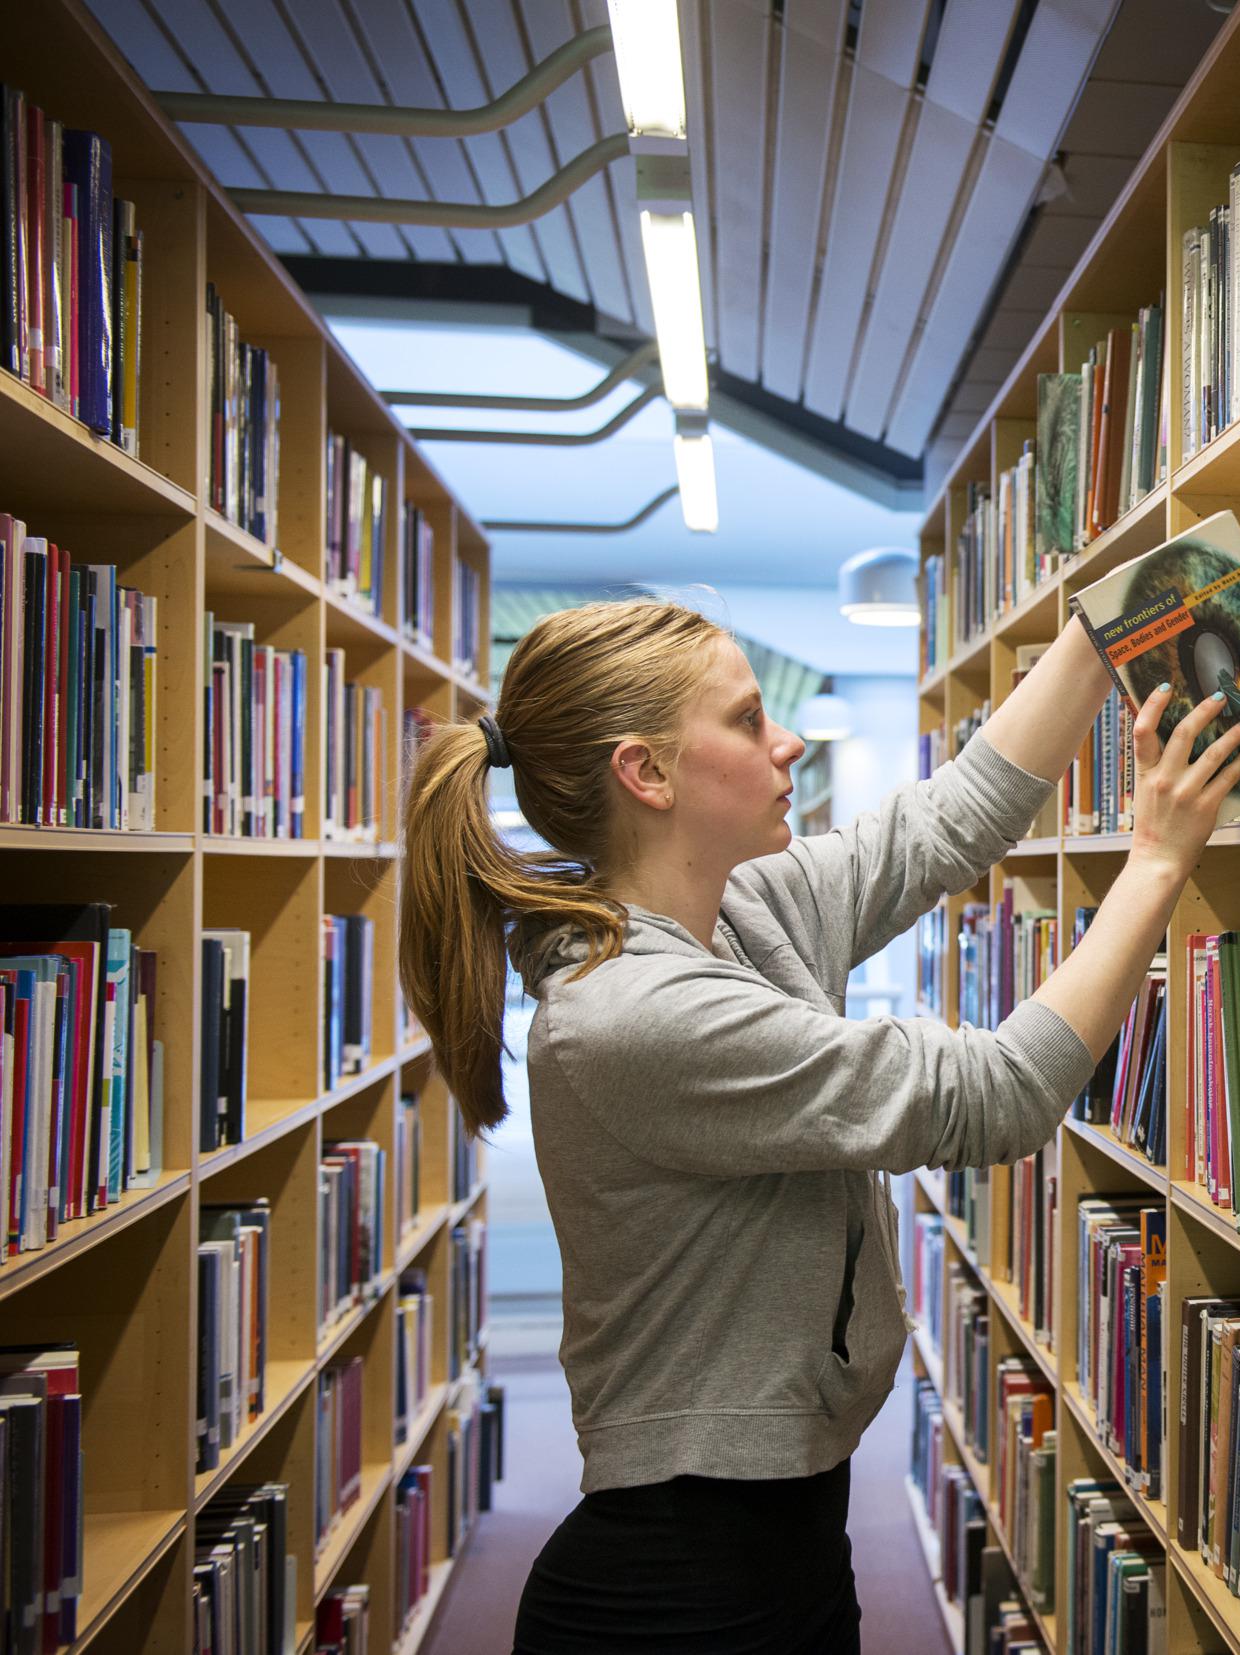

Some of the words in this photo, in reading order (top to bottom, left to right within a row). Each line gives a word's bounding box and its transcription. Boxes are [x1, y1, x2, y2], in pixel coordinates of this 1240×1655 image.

[1104, 624, 1124, 641] new
[1123, 602, 1166, 630] frontiers
[1166, 593, 1177, 606] of
[1109, 643, 1132, 661] Space,
[1131, 631, 1153, 645] Bodies
[1153, 624, 1167, 635] and
[1166, 611, 1190, 629] Gender
